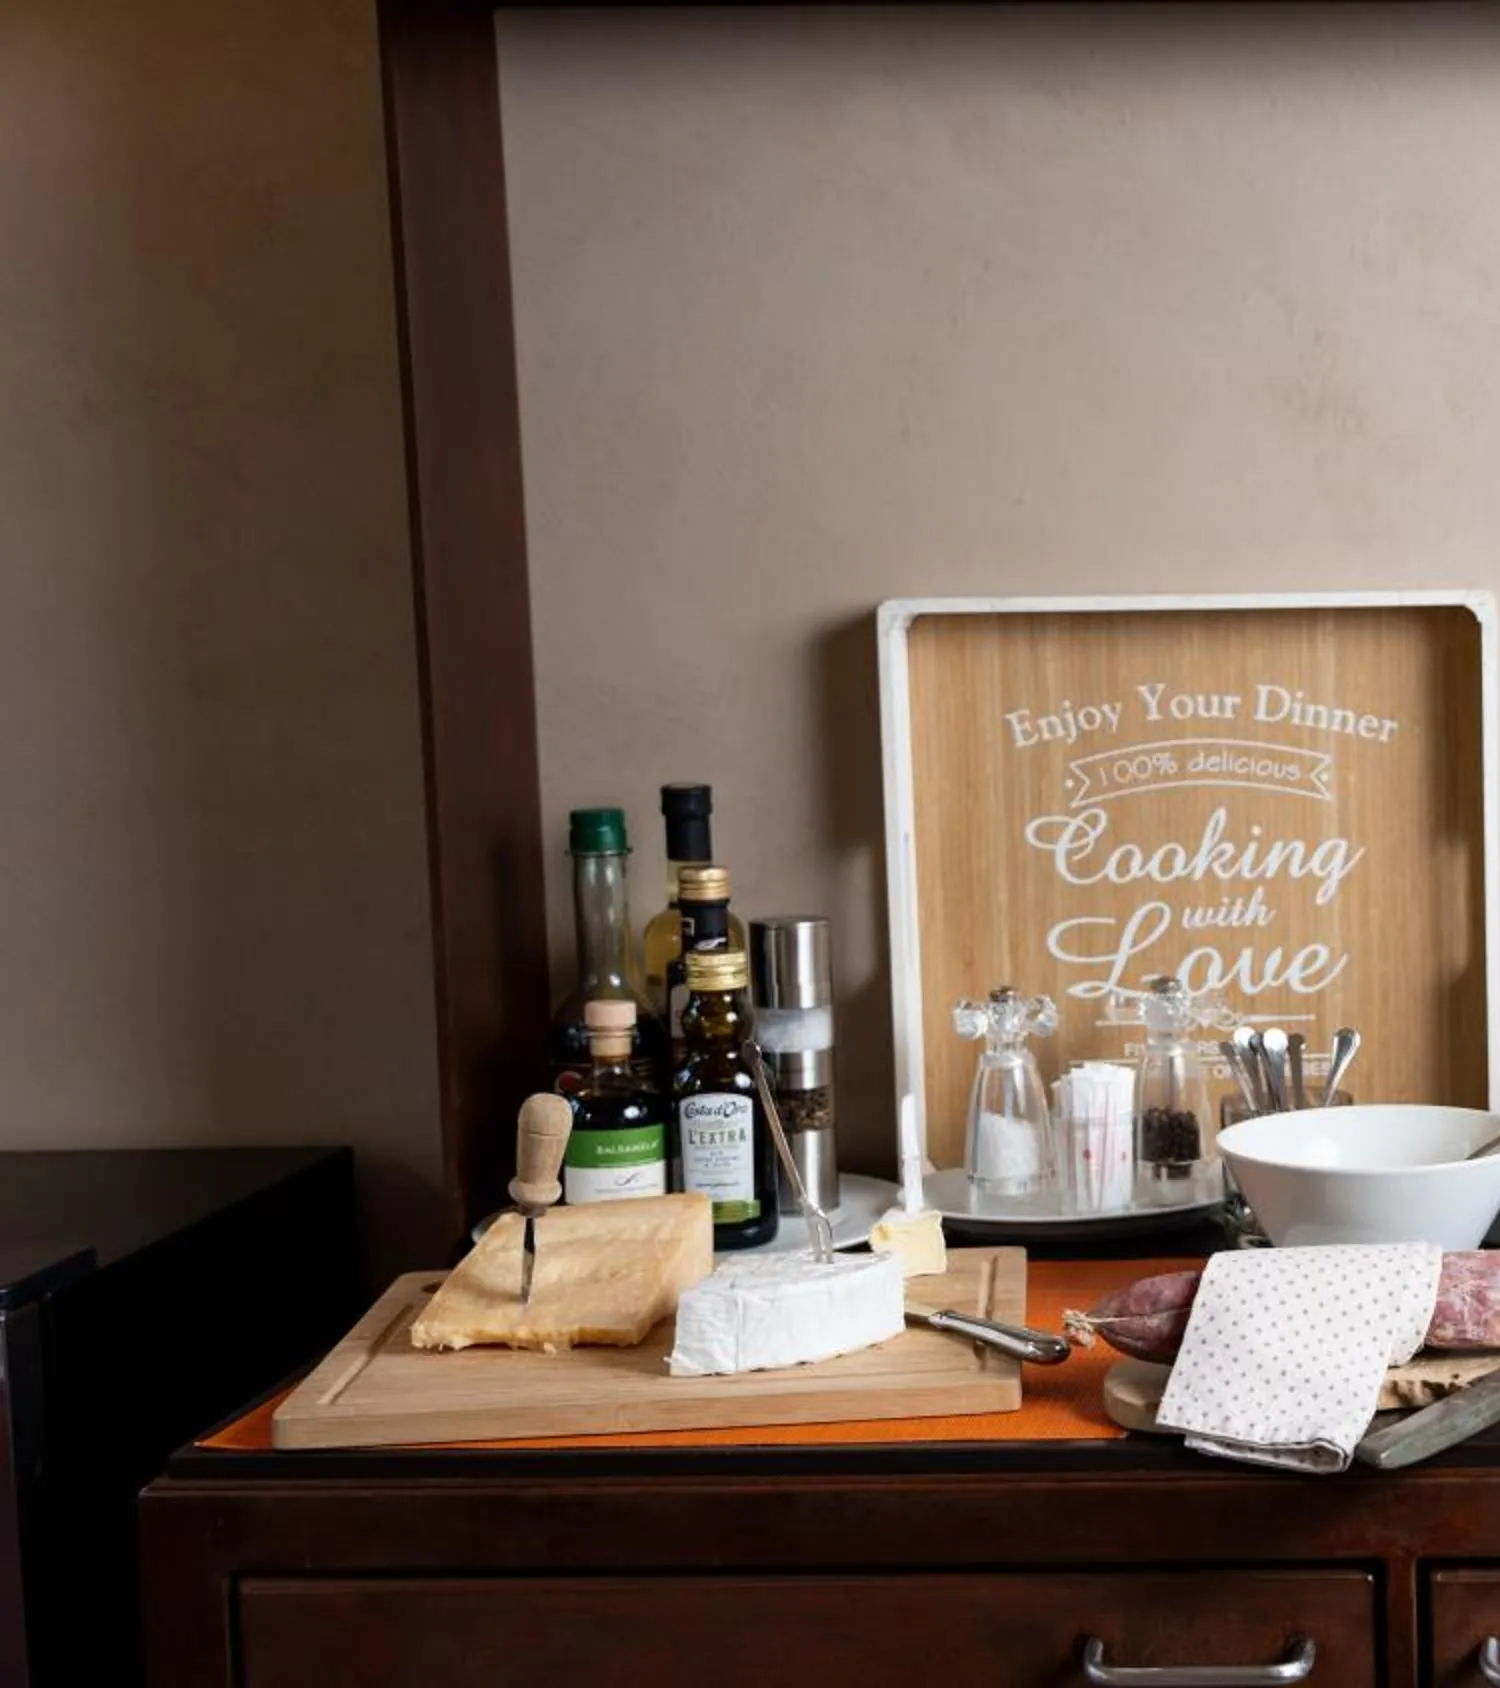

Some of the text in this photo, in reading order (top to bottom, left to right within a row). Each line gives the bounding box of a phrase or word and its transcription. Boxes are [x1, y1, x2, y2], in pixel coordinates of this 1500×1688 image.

[1005, 683, 1399, 749] Enjoy Your Dinner
[1100, 751, 1301, 786] 100% delicious
[1025, 806, 1366, 906] Cooking
[1181, 885, 1277, 929] with
[1046, 901, 1349, 999] Love
